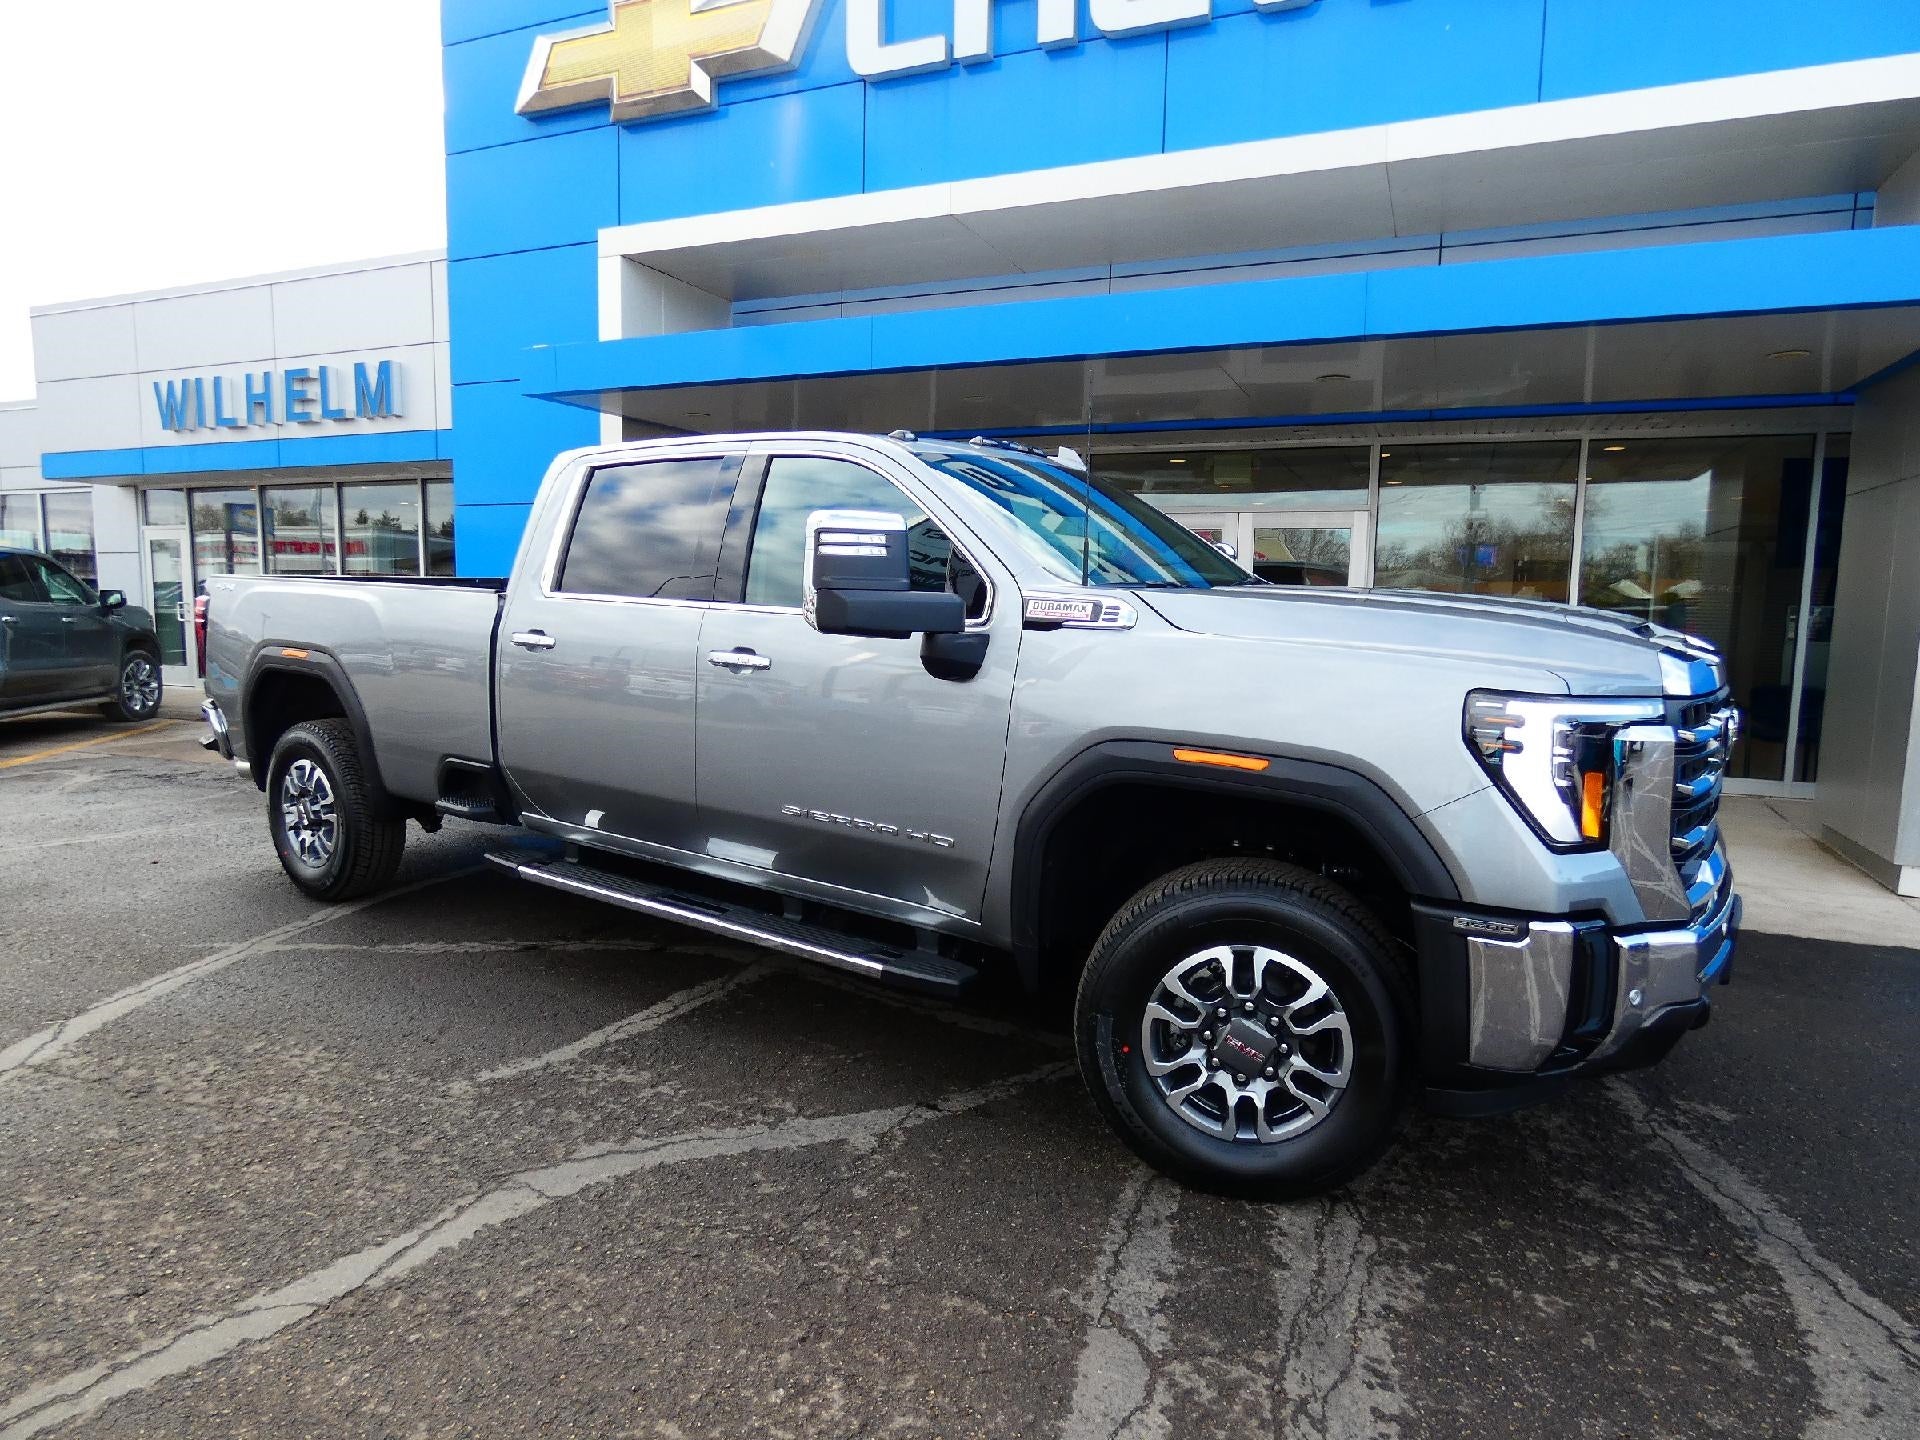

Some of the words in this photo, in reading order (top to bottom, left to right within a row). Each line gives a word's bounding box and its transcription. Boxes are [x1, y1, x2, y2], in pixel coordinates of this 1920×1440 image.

[153, 360, 394, 432] WILHELM
[1032, 601, 1088, 613] DURAMAX
[781, 804, 899, 837] SIERRA
[906, 829, 955, 849] HD
[1226, 1034, 1266, 1063] GMC
